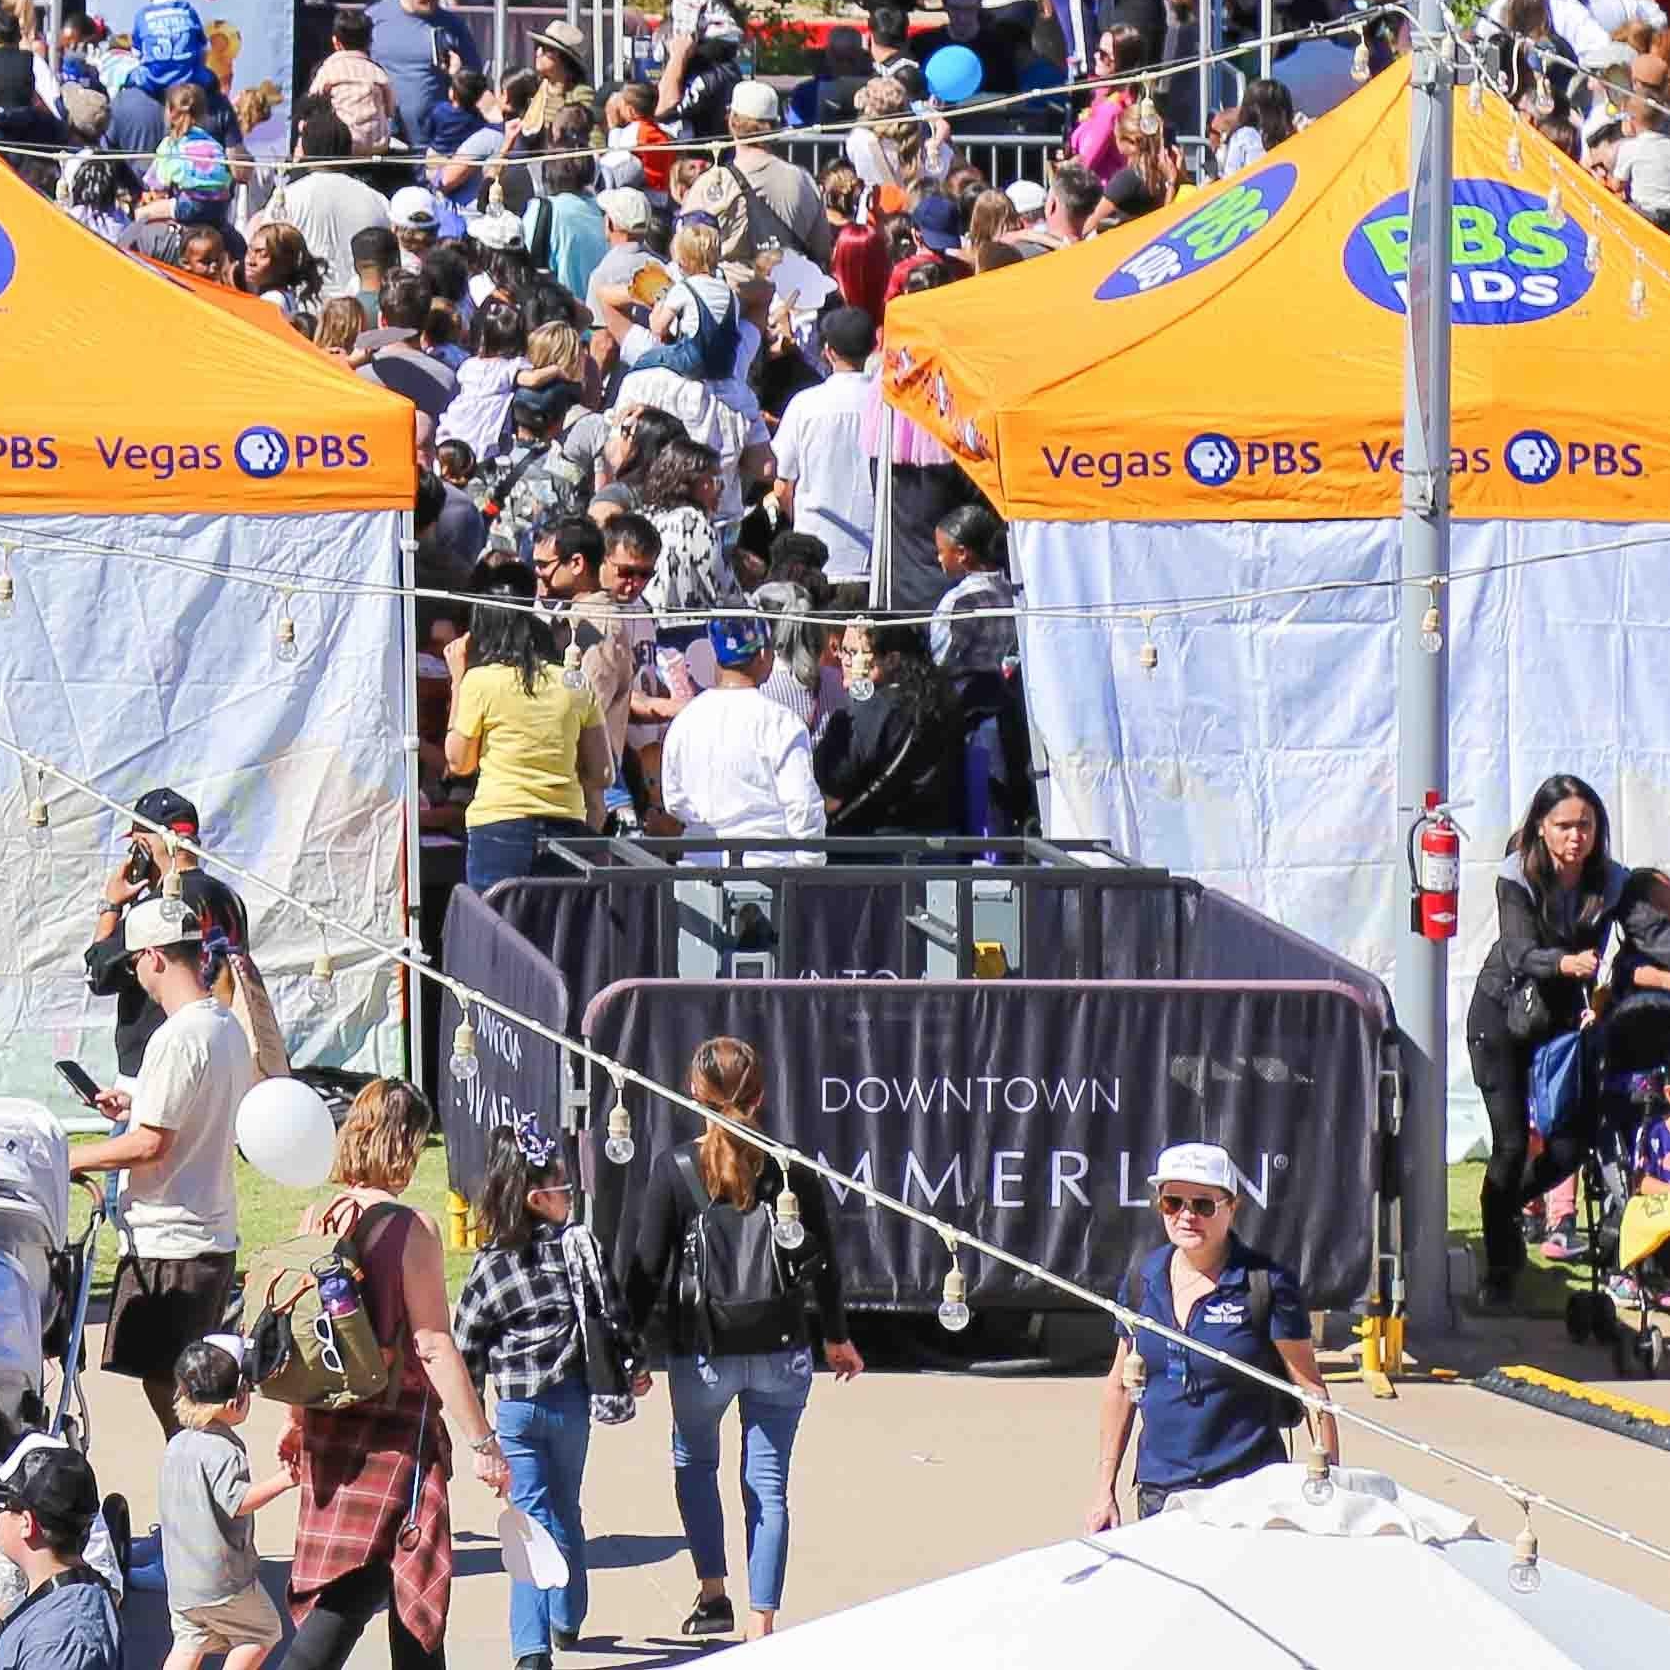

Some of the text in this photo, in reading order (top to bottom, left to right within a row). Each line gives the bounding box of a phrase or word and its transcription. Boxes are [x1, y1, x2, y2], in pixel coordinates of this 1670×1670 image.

[1363, 205, 1570, 277] PBS
[1394, 270, 1560, 308] IDS
[98, 436, 222, 479] Vegas
[297, 434, 368, 468] PBS
[1042, 441, 1643, 486] Vegas PBS Veas PBS
[820, 1076, 1119, 1114] DOWNTOWN
